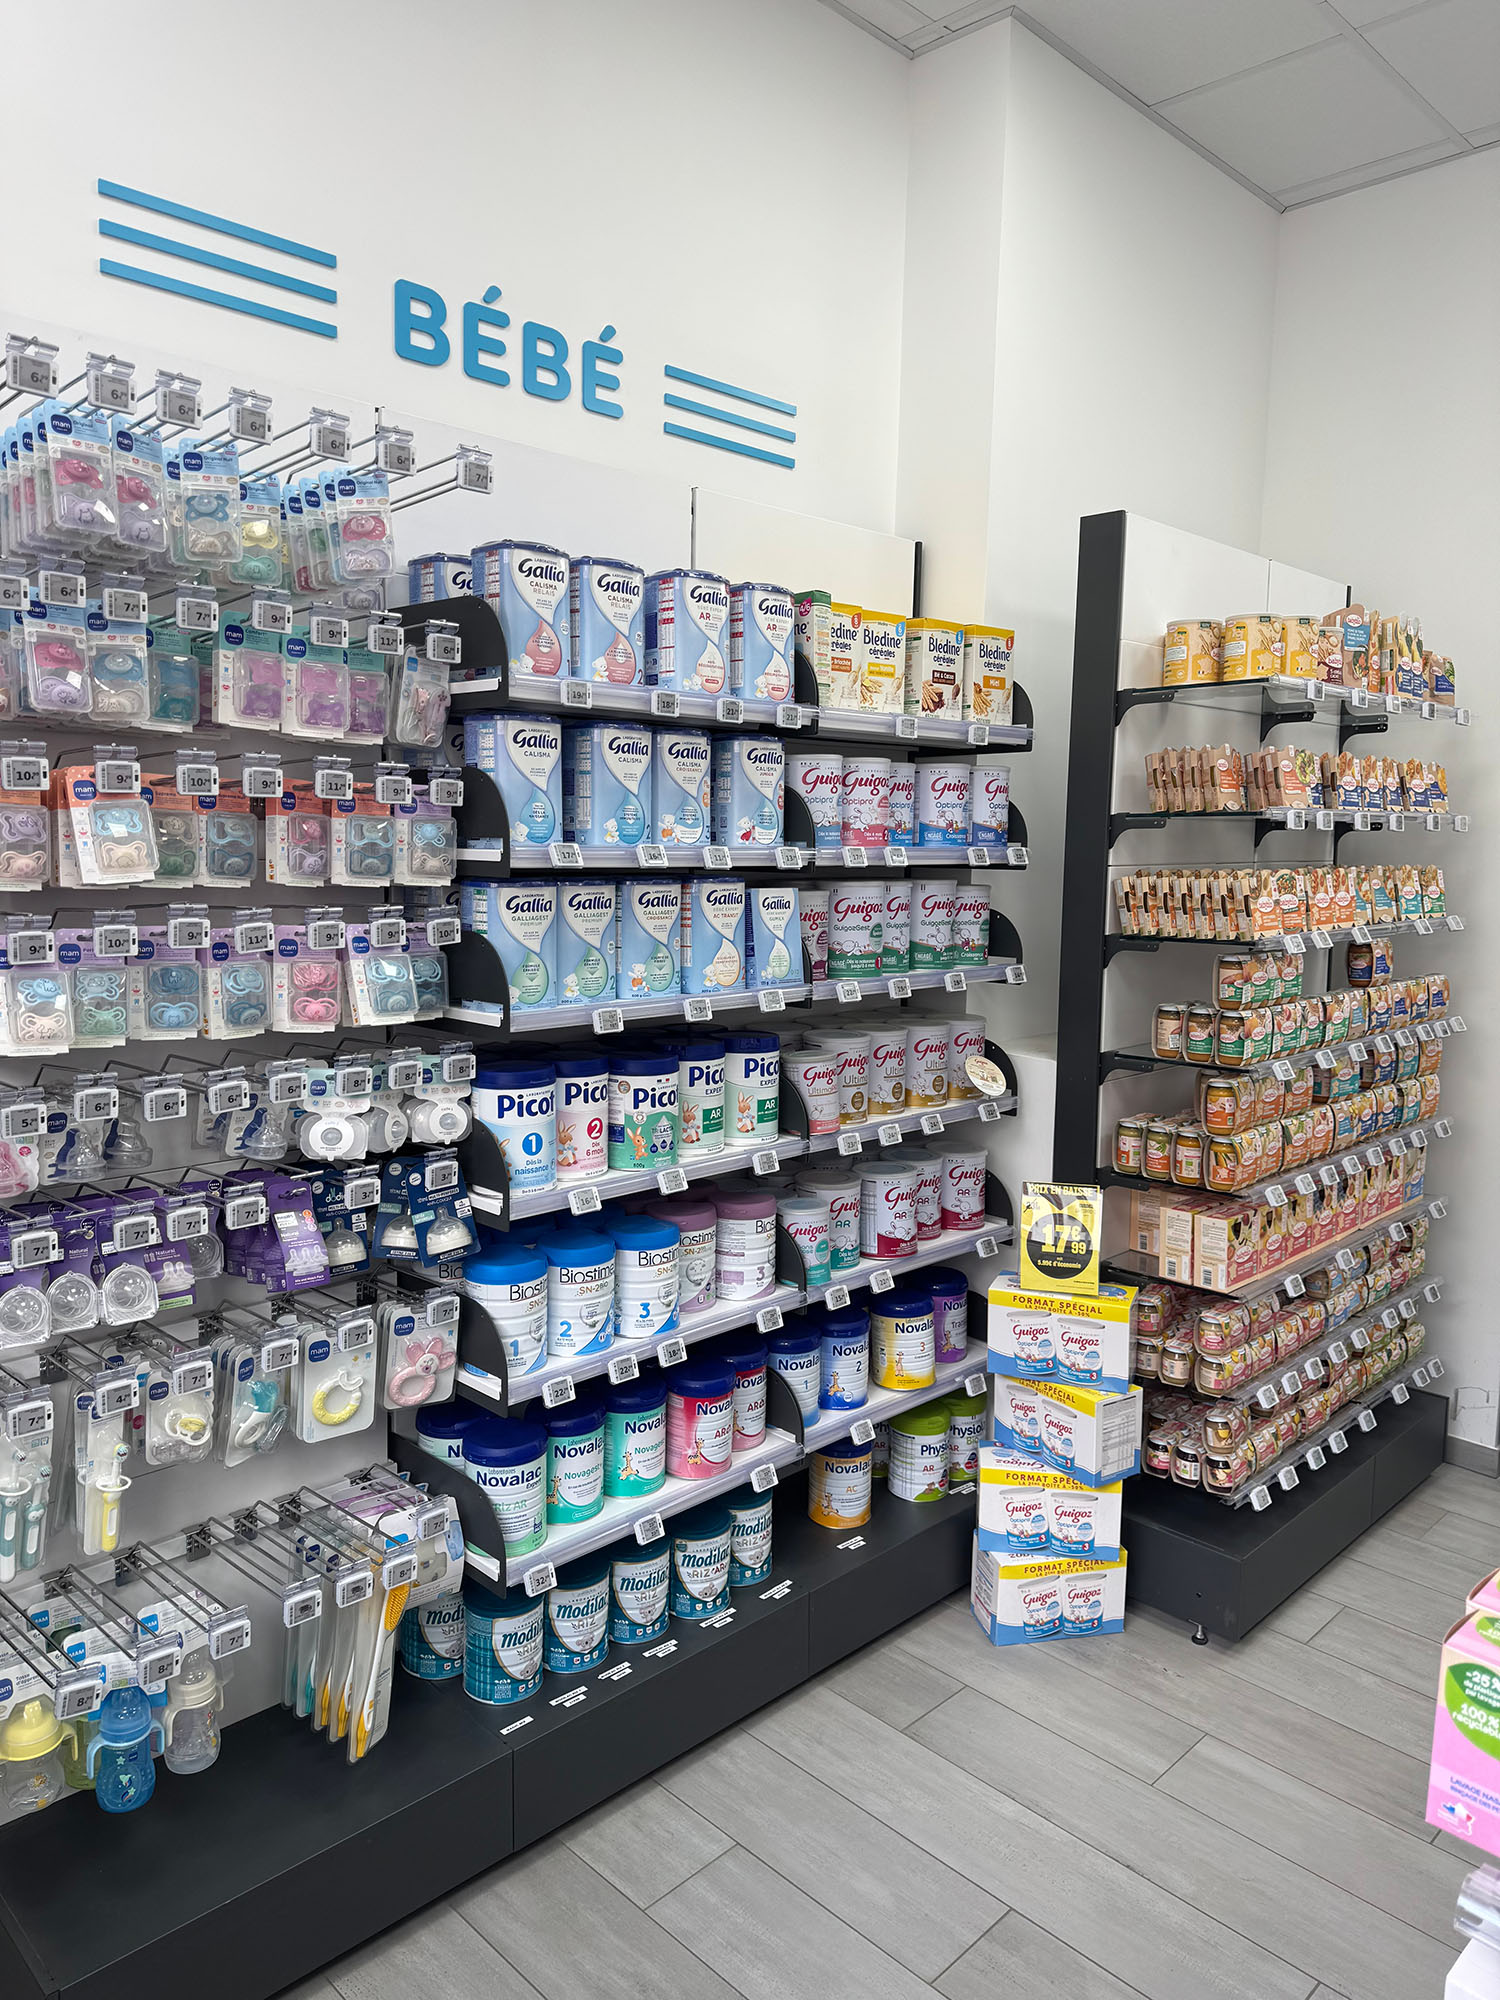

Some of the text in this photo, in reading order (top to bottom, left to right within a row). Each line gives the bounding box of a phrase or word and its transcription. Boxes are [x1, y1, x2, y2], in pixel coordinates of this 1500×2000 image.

[394, 279, 624, 419] BÉBÉ
[52, 420, 71, 429] mam
[118, 437, 132, 446] mam
[184, 457, 201, 465] mam
[518, 558, 565, 584] Gallia
[530, 581, 558, 591] CALISMA
[533, 588, 556, 597] RELAIS
[597, 573, 640, 598] Gallia
[608, 594, 633, 604] CALISMA
[690, 585, 728, 608] Gallia
[610, 602, 632, 611] RELAIS
[758, 598, 793, 619] Gallia
[699, 612, 711, 621] AR
[766, 623, 777, 632] AR
[864, 626, 901, 649] Blédine
[929, 634, 961, 656] Blédine
[869, 647, 896, 658] céréales
[979, 640, 1011, 662] Blédine
[933, 655, 956, 666] céréales
[983, 660, 1006, 671] céréales
[512, 728, 558, 750] Gallia
[608, 736, 649, 756] Gallia
[524, 750, 551, 758] CALISMA
[668, 742, 708, 761] Gallia
[747, 748, 782, 766] Gallia
[618, 756, 642, 764] CALISMA
[677, 761, 702, 769] CALISMA
[842, 797, 873, 807] Optipro
[936, 801, 964, 811] Optipro
[505, 895, 552, 914] Gallia
[568, 893, 612, 911] Gallia
[638, 891, 678, 909] Gallia
[706, 889, 743, 906] Gallia
[762, 896, 791, 911] Gallia
[834, 897, 882, 922] Guigoz
[565, 1082, 608, 1106] Pico
[765, 1100, 776, 1109] AR
[710, 1109, 721, 1119] AR
[590, 1119, 601, 1138] 2
[528, 1134, 536, 1153] 1
[592, 1148, 604, 1156] mois
[514, 1164, 549, 1176] naissance
[957, 1188, 970, 1196] AR
[1029, 1183, 1093, 1197] PRIX EN BAISSE
[894, 1211, 907, 1219] AR
[835, 1220, 850, 1228] AR
[786, 1222, 829, 1242] Guigoz
[155, 1248, 175, 1257] Natural
[755, 1266, 765, 1281] 3
[639, 1302, 651, 1319] 3
[1012, 1295, 1103, 1315] FORMAT SPÉCIAL
[559, 1320, 572, 1338] 2
[1012, 1324, 1050, 1341] Guigoz
[509, 1339, 520, 1357] 1
[919, 1341, 925, 1352] 3
[1061, 1331, 1100, 1351] Guigoz
[855, 1360, 862, 1372] 2
[150, 1386, 168, 1394] mam
[803, 1380, 809, 1390] 1
[1044, 1383, 1076, 1403] SPÉCIAL
[1010, 1398, 1037, 1418] Guigoz
[1044, 1413, 1073, 1437] Guigoz
[922, 1464, 934, 1473] AR
[476, 1466, 542, 1487] Novalac
[1006, 1472, 1049, 1483] FORMAT
[846, 1484, 857, 1494] AC
[1005, 1501, 1043, 1517] Guigoz
[1054, 1505, 1093, 1523] Guigoz
[741, 1537, 758, 1547] RIZ
[692, 1568, 710, 1578] RIZ
[1024, 1558, 1104, 1574] FORMAT SPÉCIAL
[640, 1591, 657, 1602] RIZ
[1023, 1590, 1058, 1609] Guigoz
[1068, 1588, 1102, 1604] Guigoz
[577, 1617, 596, 1630] RIZ
[1461, 1703, 1499, 1729] 100 %
[1450, 1776, 1481, 1795] LAVAGE
